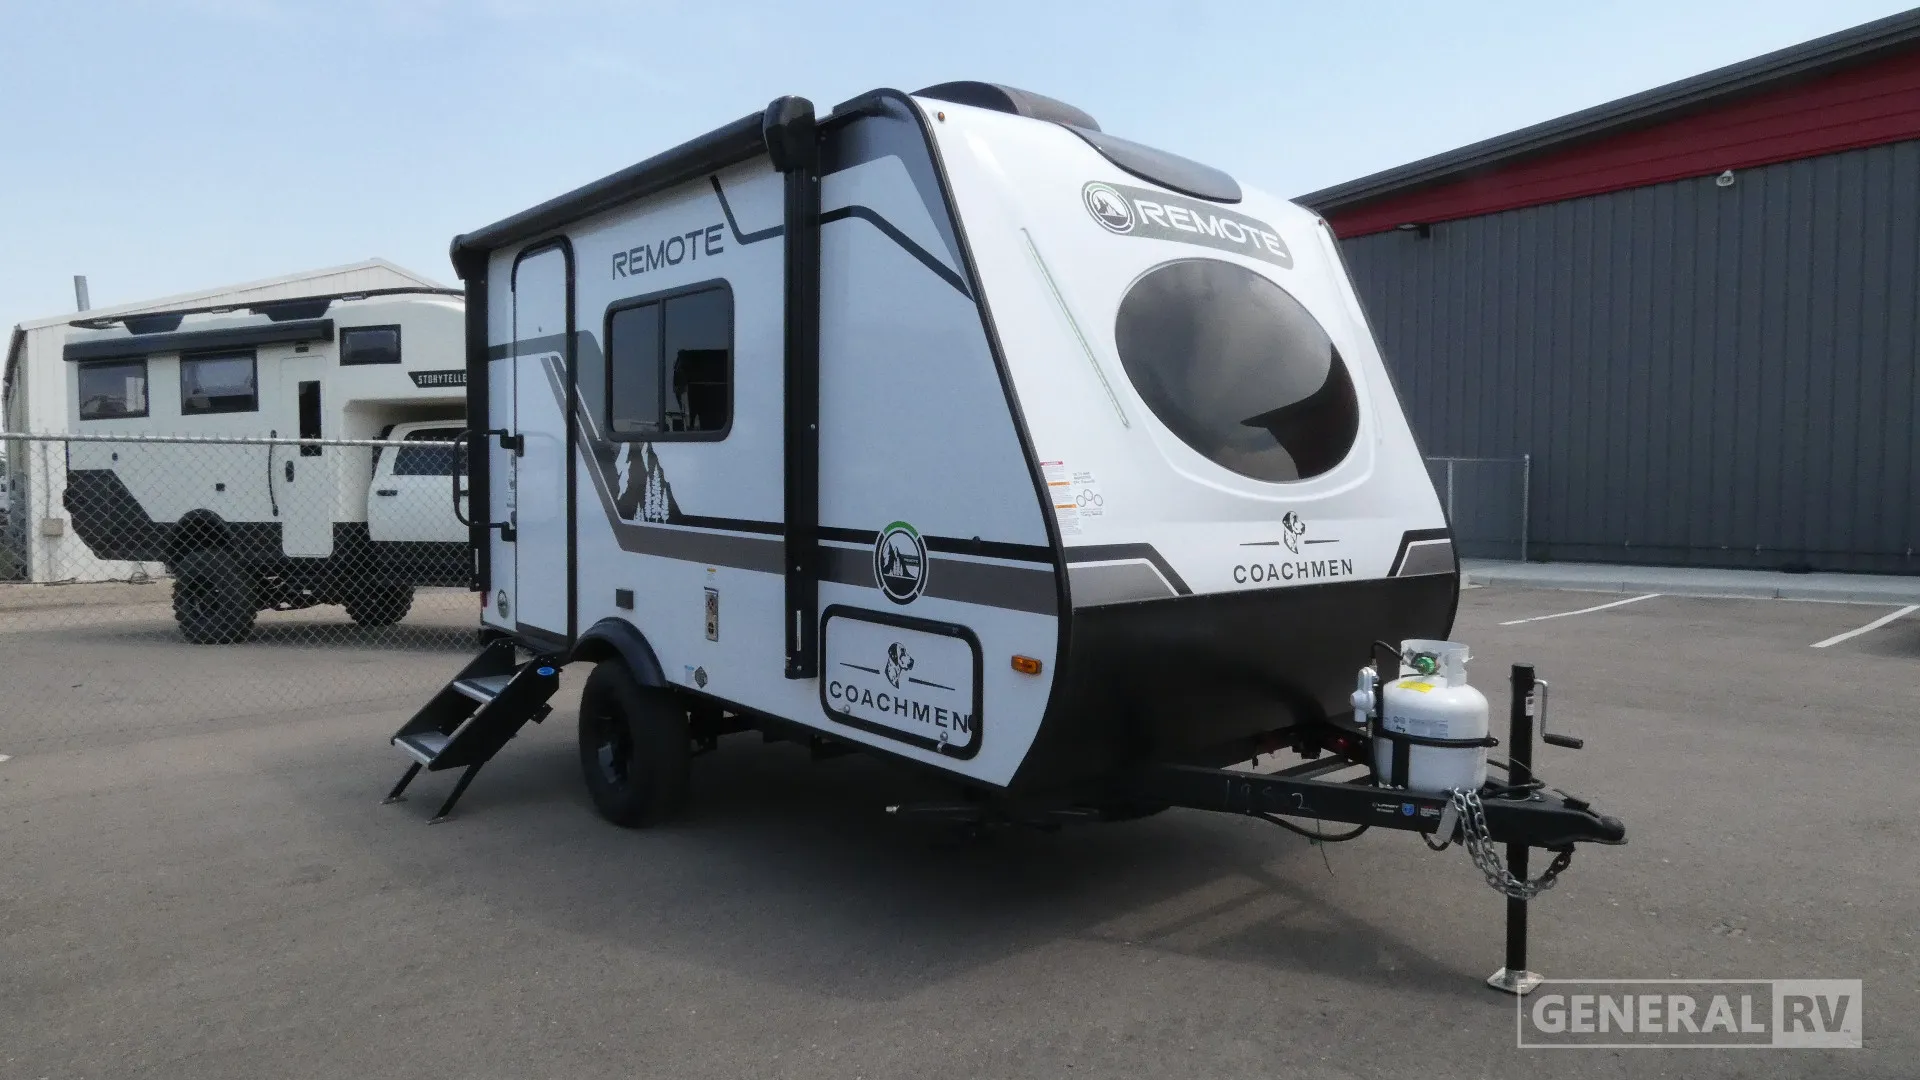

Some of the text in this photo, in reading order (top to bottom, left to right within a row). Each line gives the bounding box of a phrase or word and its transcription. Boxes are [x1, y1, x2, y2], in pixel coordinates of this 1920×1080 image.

[612, 222, 724, 280] REMOTE
[1134, 199, 1287, 258] REMOTE
[1233, 559, 1353, 584] COACHMEN
[829, 680, 968, 734] COACHMEN
